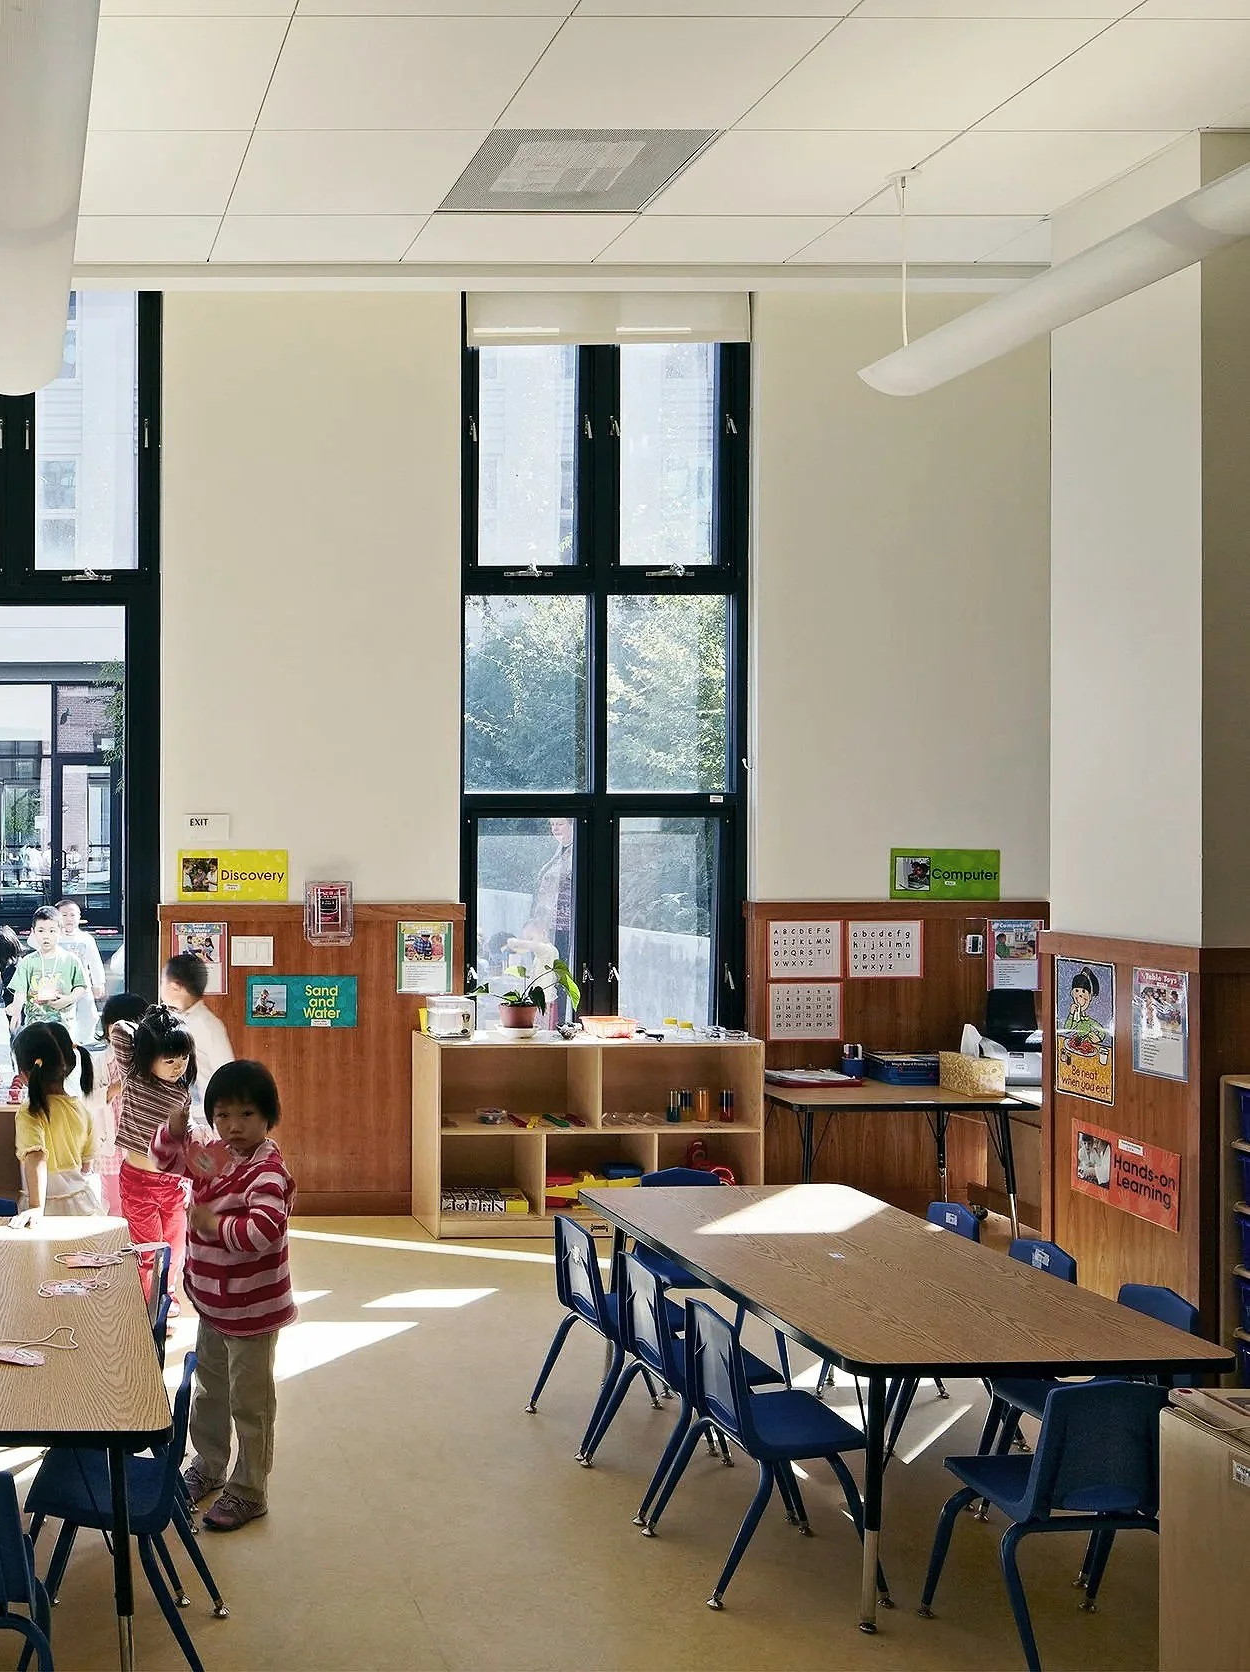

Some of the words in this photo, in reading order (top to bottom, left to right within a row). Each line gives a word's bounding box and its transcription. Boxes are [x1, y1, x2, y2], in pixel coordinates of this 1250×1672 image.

[190, 818, 209, 826] EXIT
[221, 869, 285, 884] Discovery
[932, 868, 998, 882] Computer
[305, 984, 338, 996] Sand
[309, 996, 335, 1007] and
[303, 1007, 340, 1019] Water
[1072, 1064, 1080, 1076] Be
[1081, 1070, 1098, 1080] neat
[1062, 1076, 1080, 1087] when
[1080, 1080, 1095, 1092] you
[1096, 1085, 1110, 1095] eat
[1114, 1153, 1176, 1191] Hands-on
[1116, 1171, 1172, 1210] Learning
